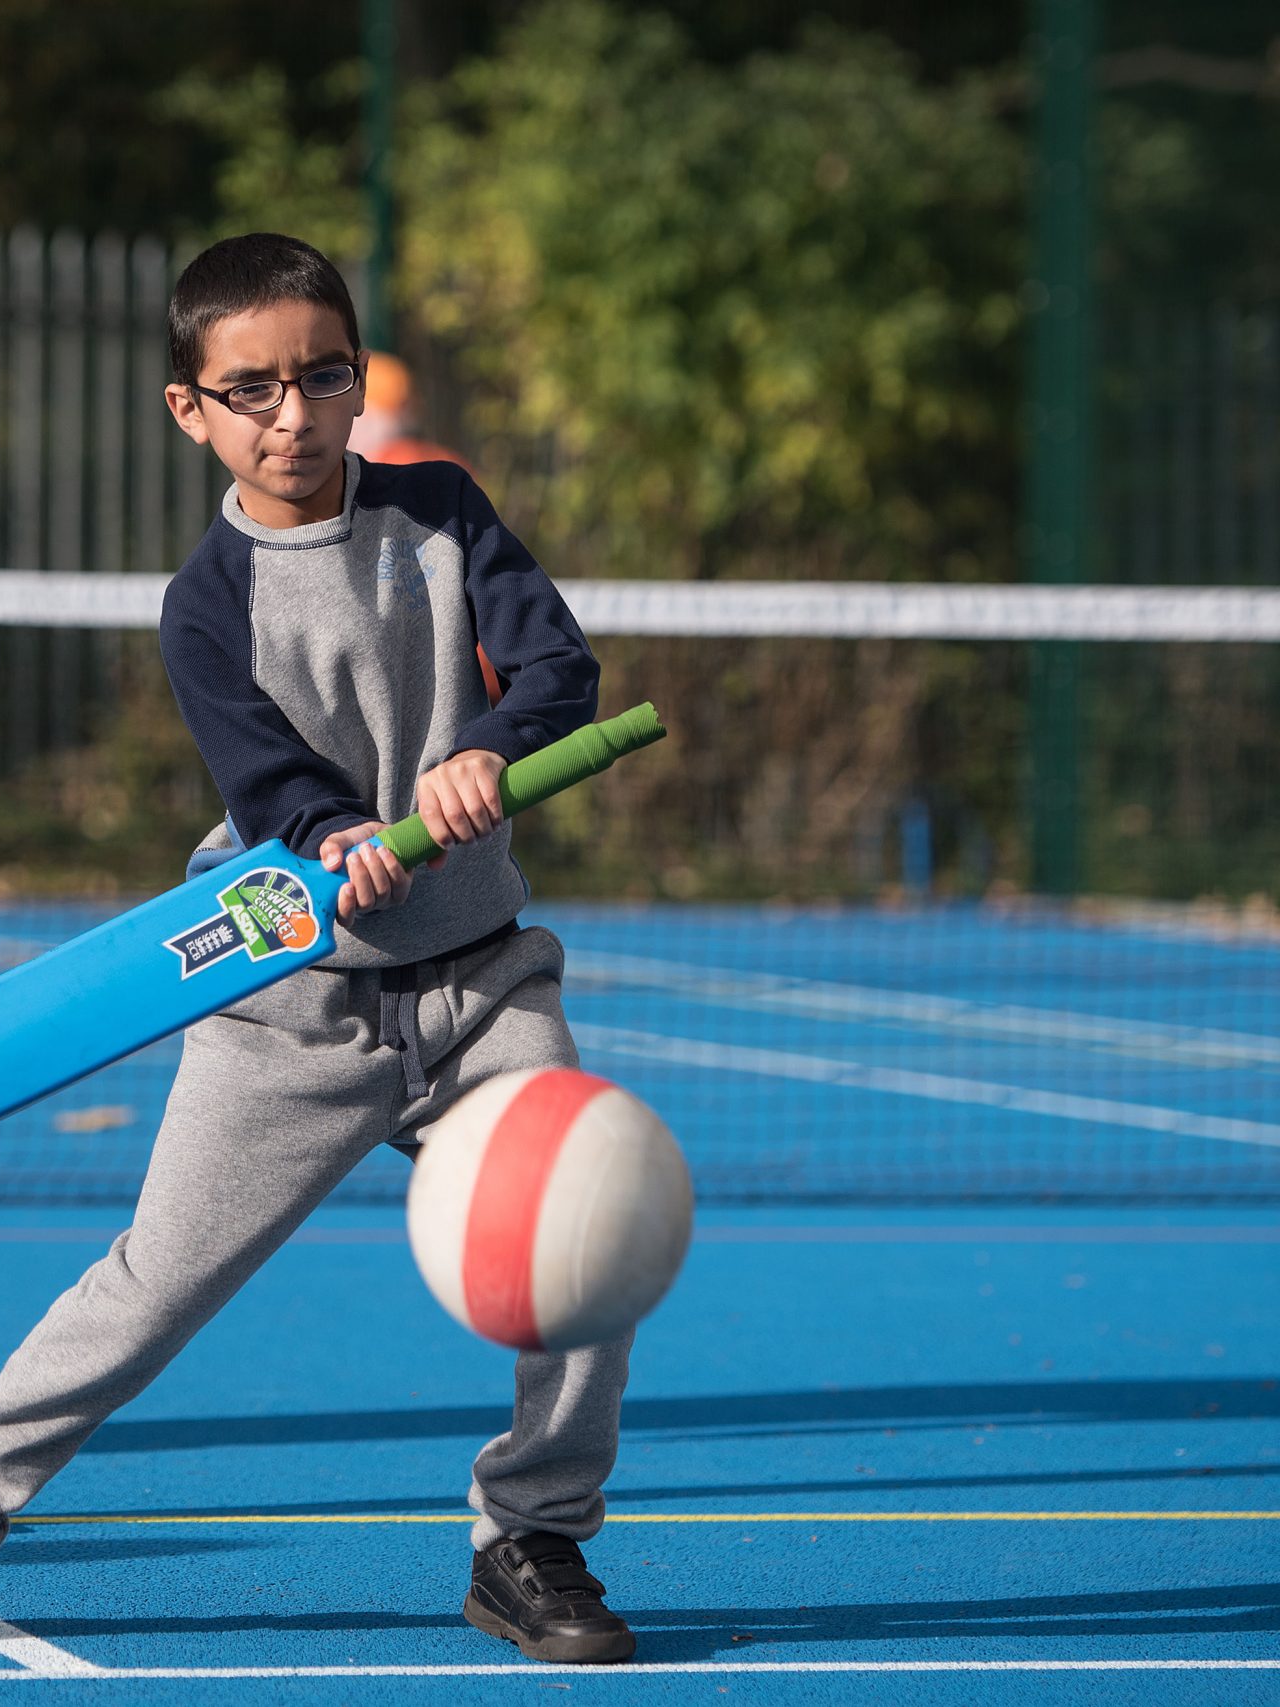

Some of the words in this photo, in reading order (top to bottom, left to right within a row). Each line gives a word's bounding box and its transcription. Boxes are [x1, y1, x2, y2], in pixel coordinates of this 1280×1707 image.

[254, 897, 297, 940] CRICKET
[258, 890, 296, 917] KWIK
[229, 904, 260, 945] ASDA
